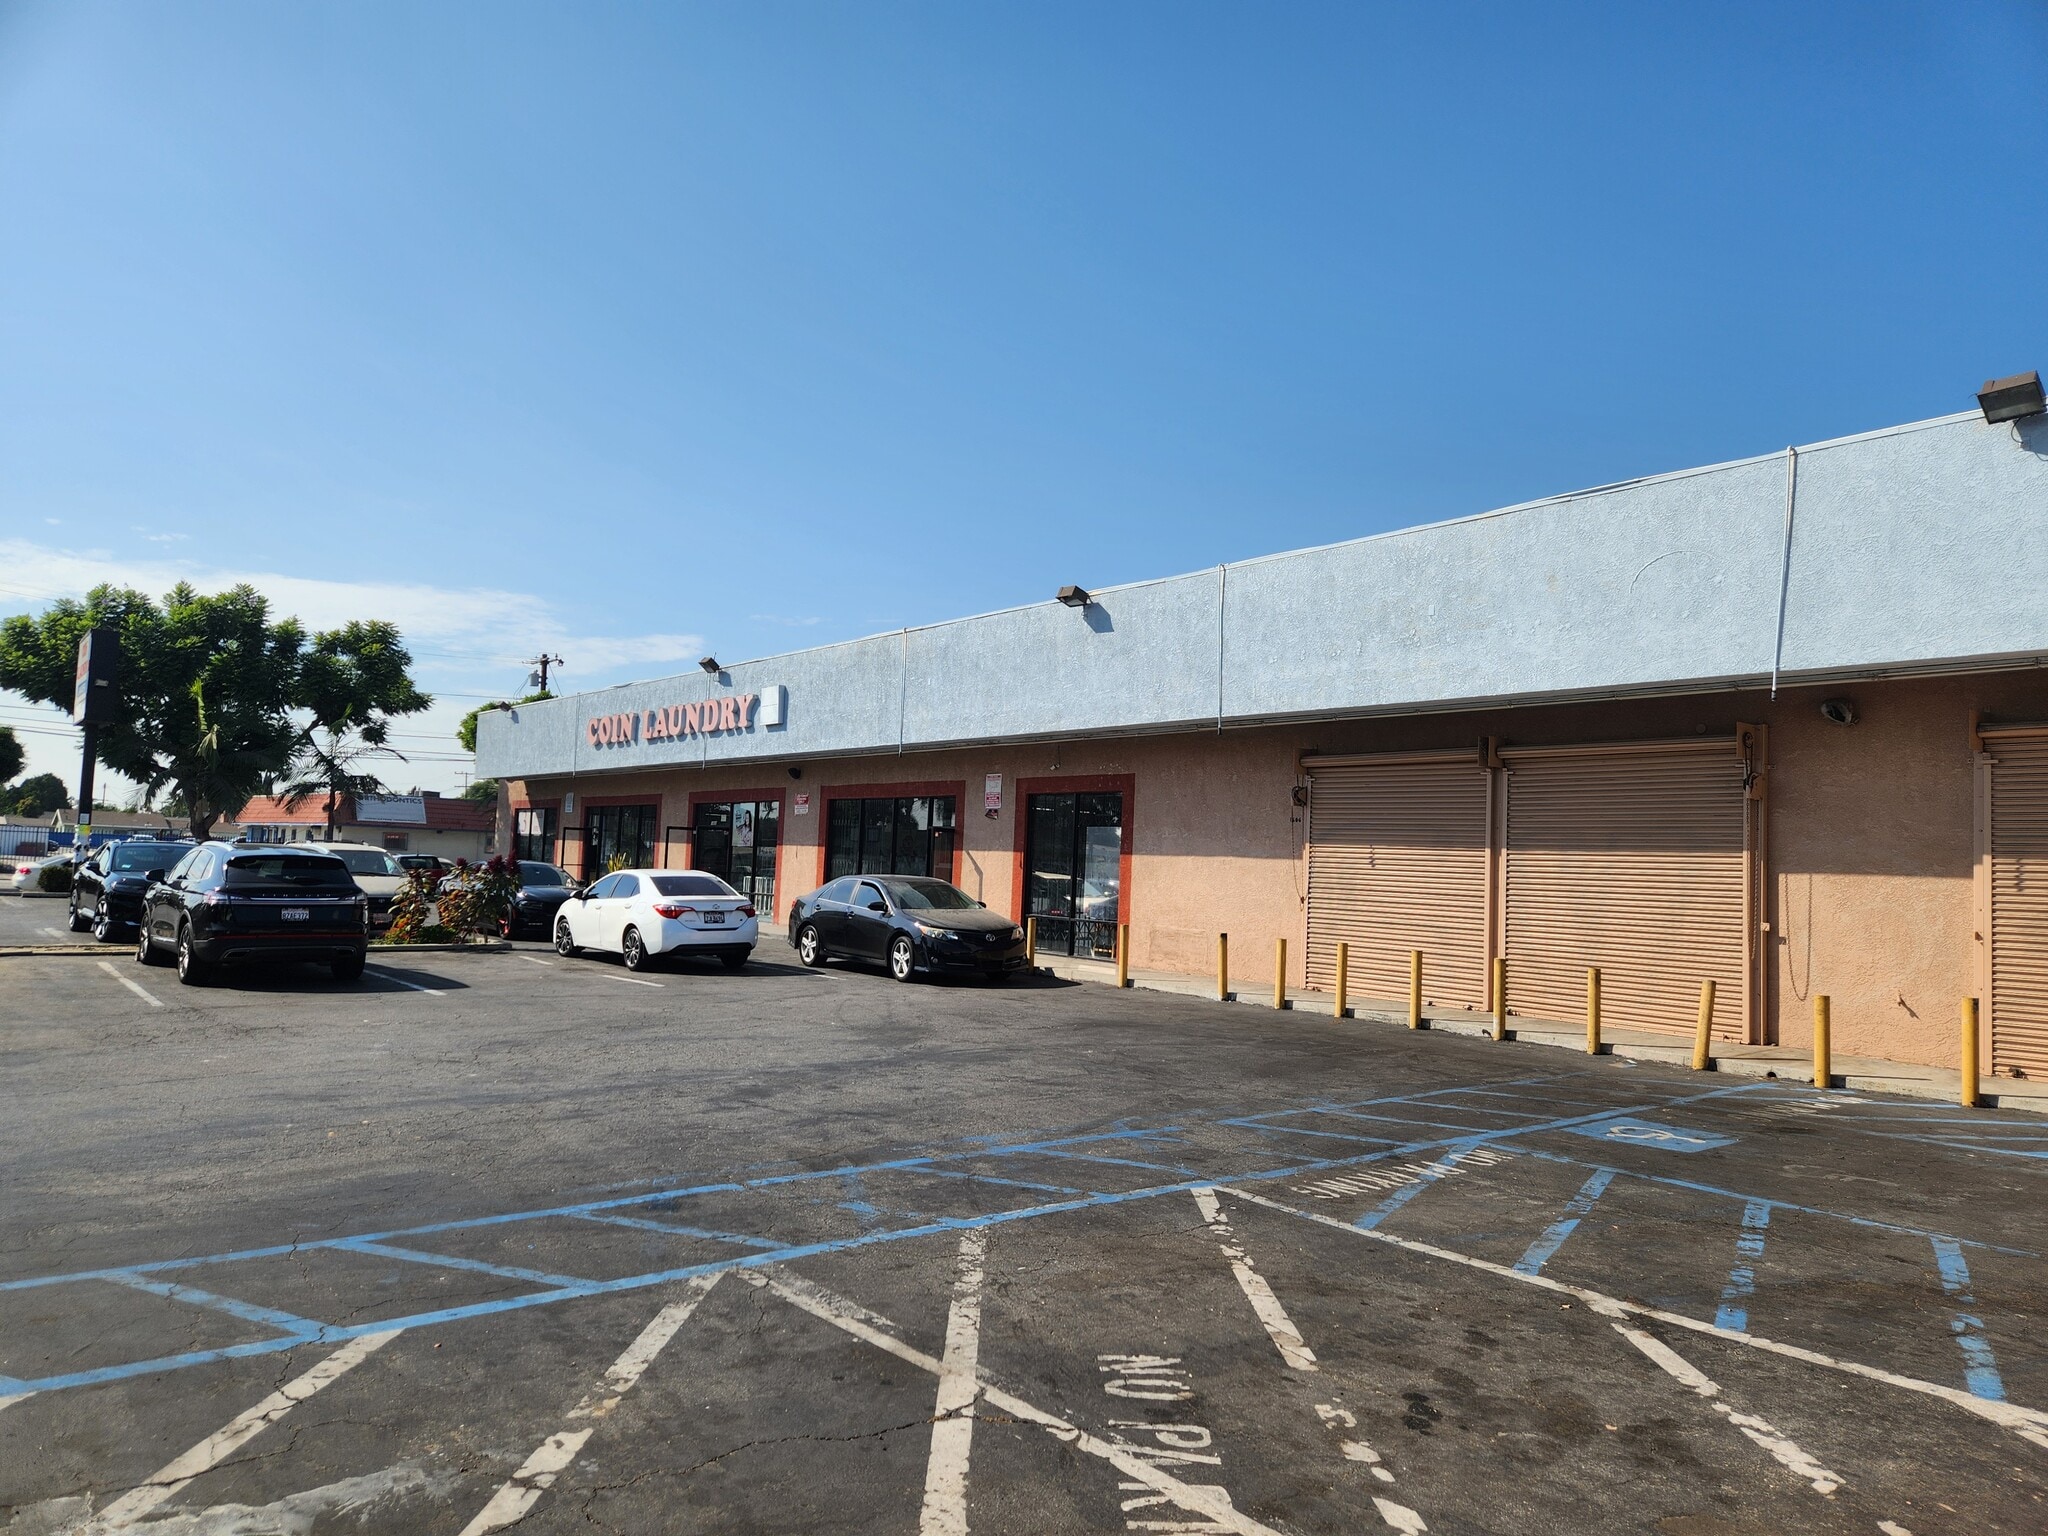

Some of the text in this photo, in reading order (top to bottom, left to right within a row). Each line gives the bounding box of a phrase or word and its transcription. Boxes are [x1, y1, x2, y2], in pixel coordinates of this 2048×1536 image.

[586, 693, 758, 746] COIN LAUNDRY
[1097, 1354, 1194, 1402] NO
